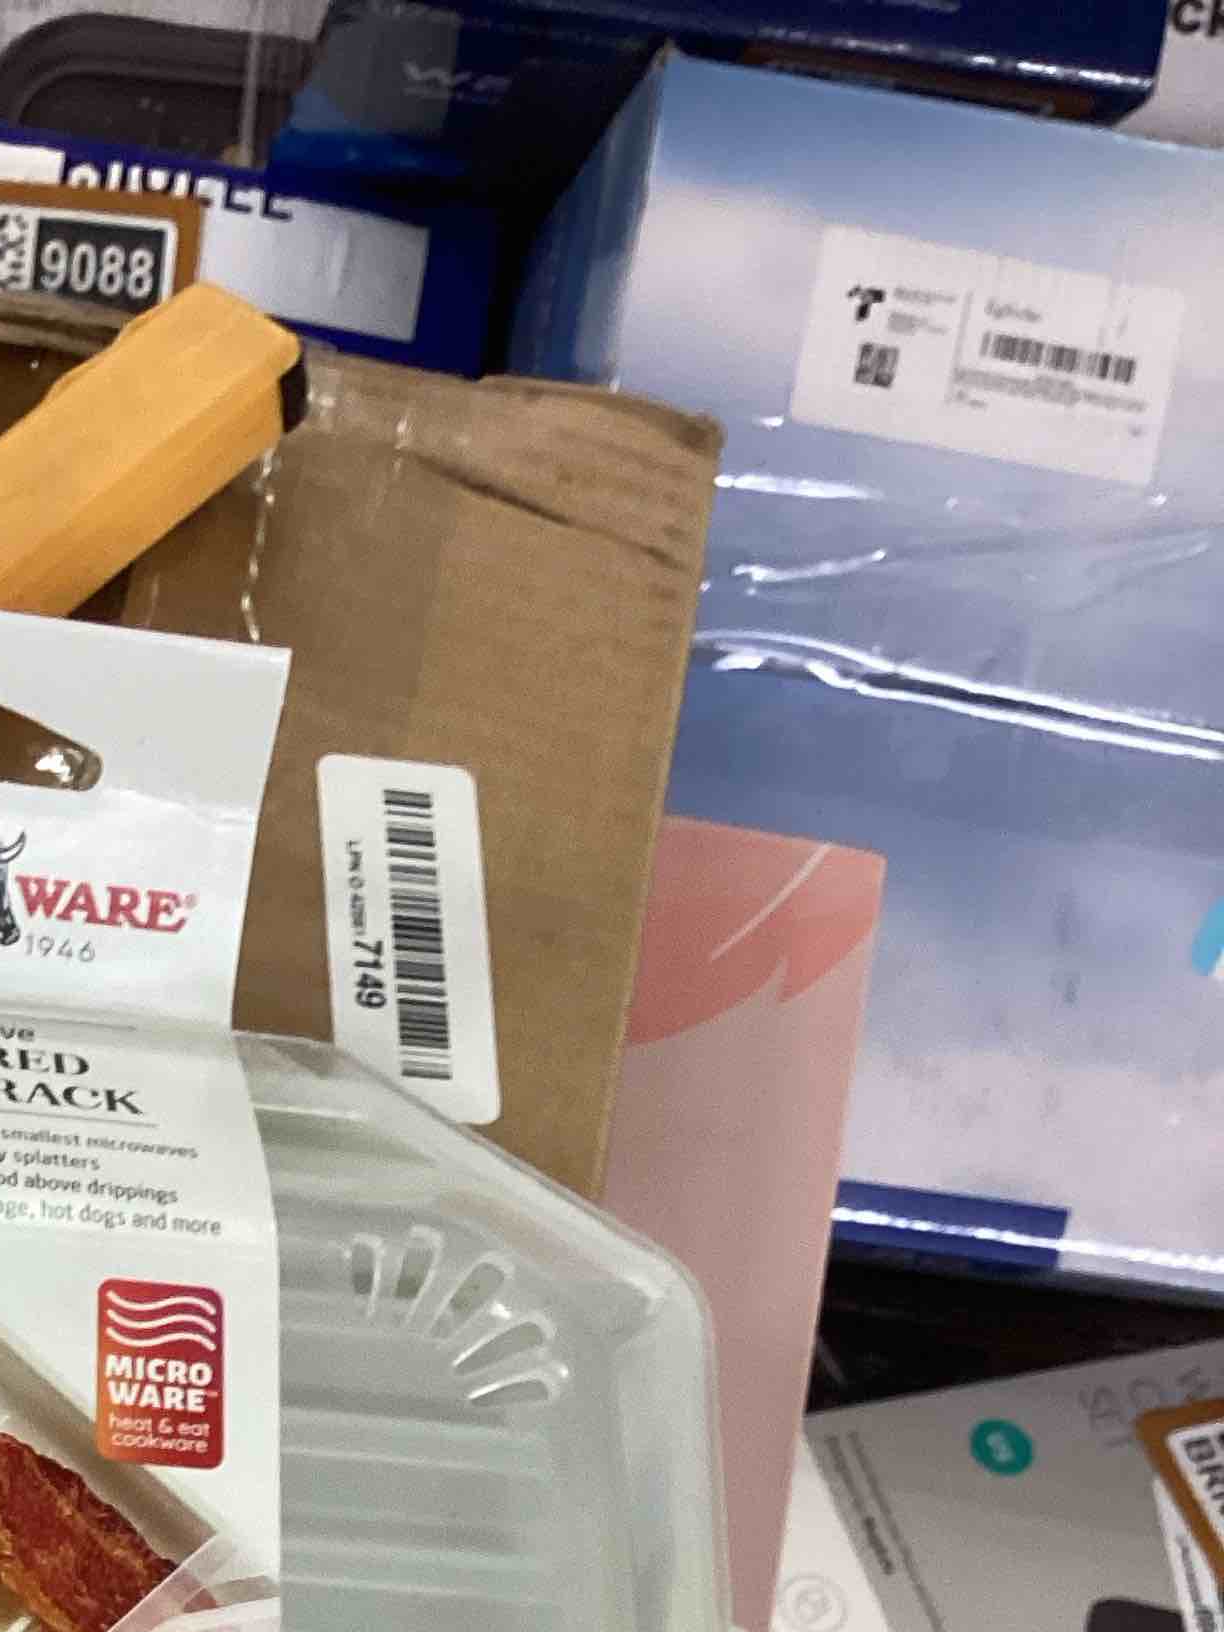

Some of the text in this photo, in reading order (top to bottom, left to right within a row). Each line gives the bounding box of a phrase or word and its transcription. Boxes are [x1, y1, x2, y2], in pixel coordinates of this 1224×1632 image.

[40, 238, 155, 299] 9088
[25, 934, 96, 963] 1946
[352, 939, 388, 1011] 7149
[1, 1128, 81, 1148] smallest
[86, 1137, 200, 1160] microwaves
[13, 1150, 101, 1172] splatters
[24, 1174, 82, 1194] above
[87, 1178, 179, 1206] drippings
[41, 1199, 74, 1222] hot
[79, 1203, 127, 1230] dogs
[131, 1211, 168, 1231] and
[172, 1216, 222, 1236] more
[105, 1354, 214, 1388] MICRO
[108, 1379, 207, 1413] WARE
[109, 1411, 210, 1438] heat & eat
[111, 1430, 210, 1454] cookware
